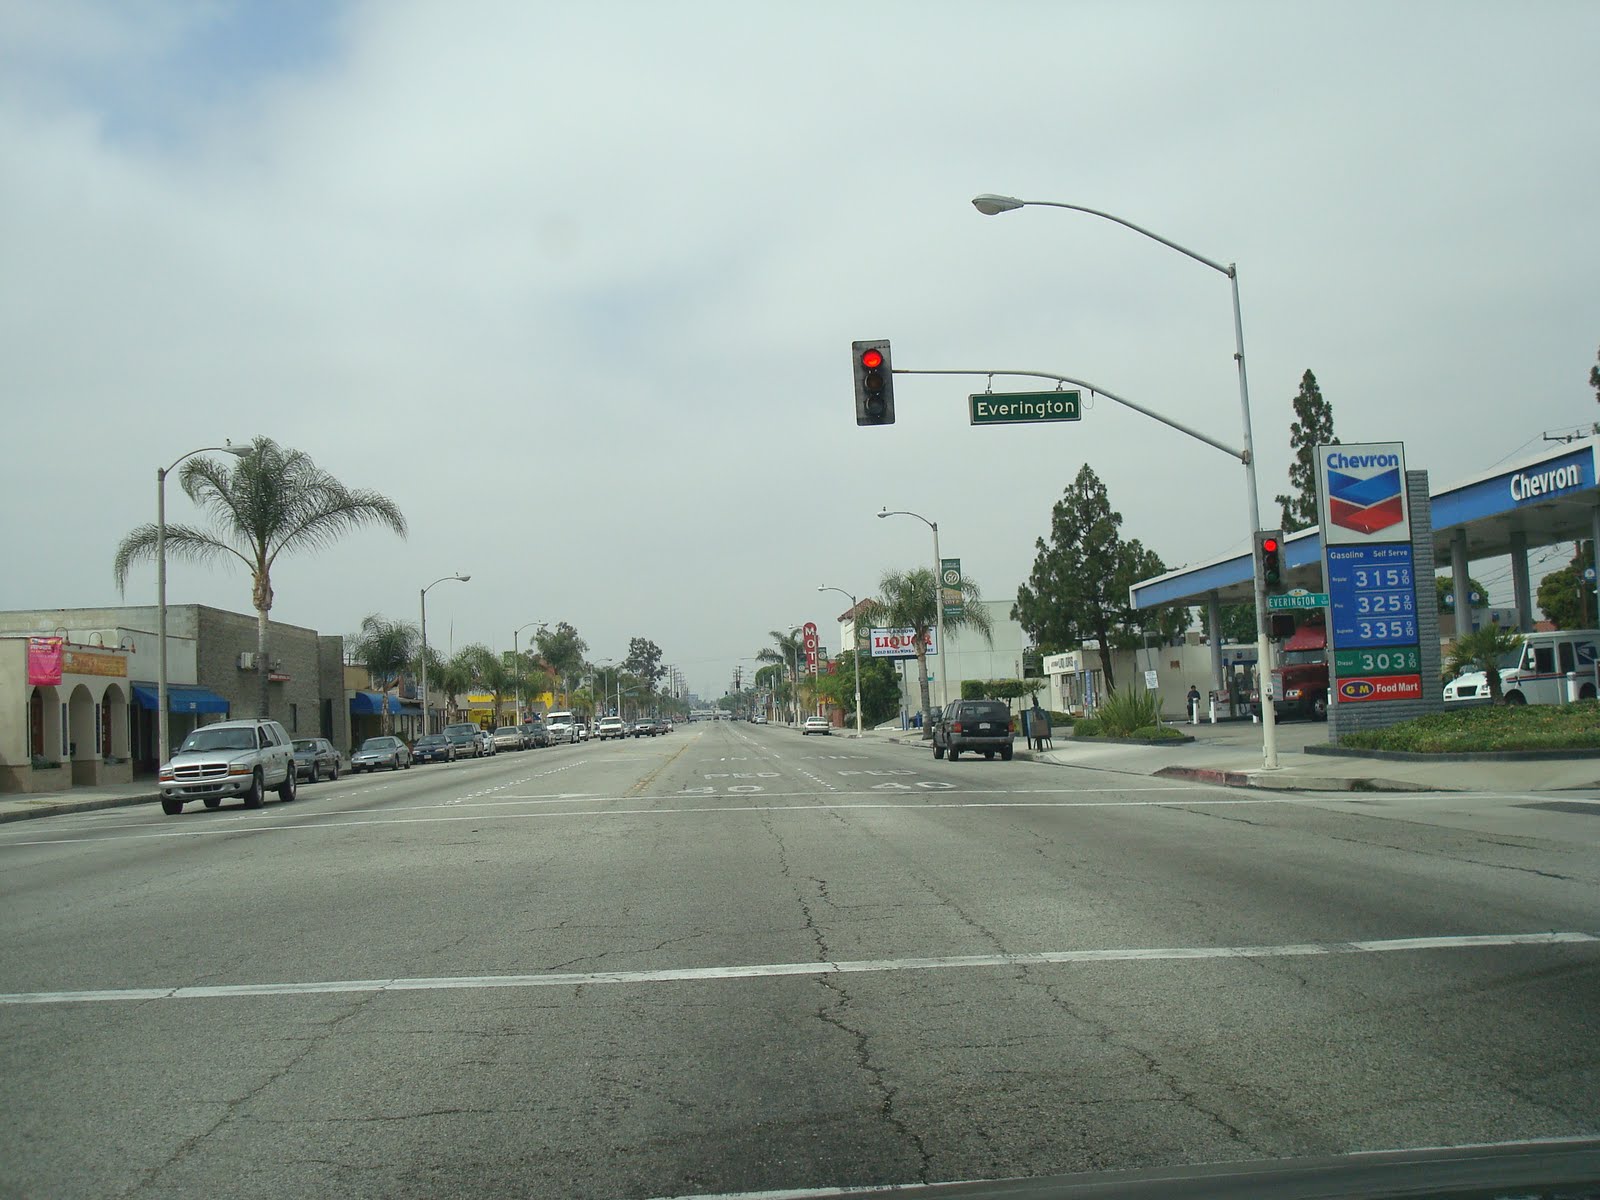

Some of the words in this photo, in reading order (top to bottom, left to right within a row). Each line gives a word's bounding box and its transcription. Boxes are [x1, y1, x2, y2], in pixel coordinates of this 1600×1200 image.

[977, 400, 1074, 418] Everington
[1326, 452, 1399, 469] Chevron
[1510, 464, 1579, 501] Chevron
[1330, 551, 1364, 559] Gasoline
[1356, 570, 1399, 587] 315
[1269, 597, 1315, 607] EVERINGTON
[1358, 595, 1401, 613] 325
[1360, 621, 1403, 639] 335
[805, 626, 817, 673] MOTE
[1362, 653, 1405, 671] 303
[1376, 683, 1397, 693] Food
[1398, 682, 1418, 692] Mart
